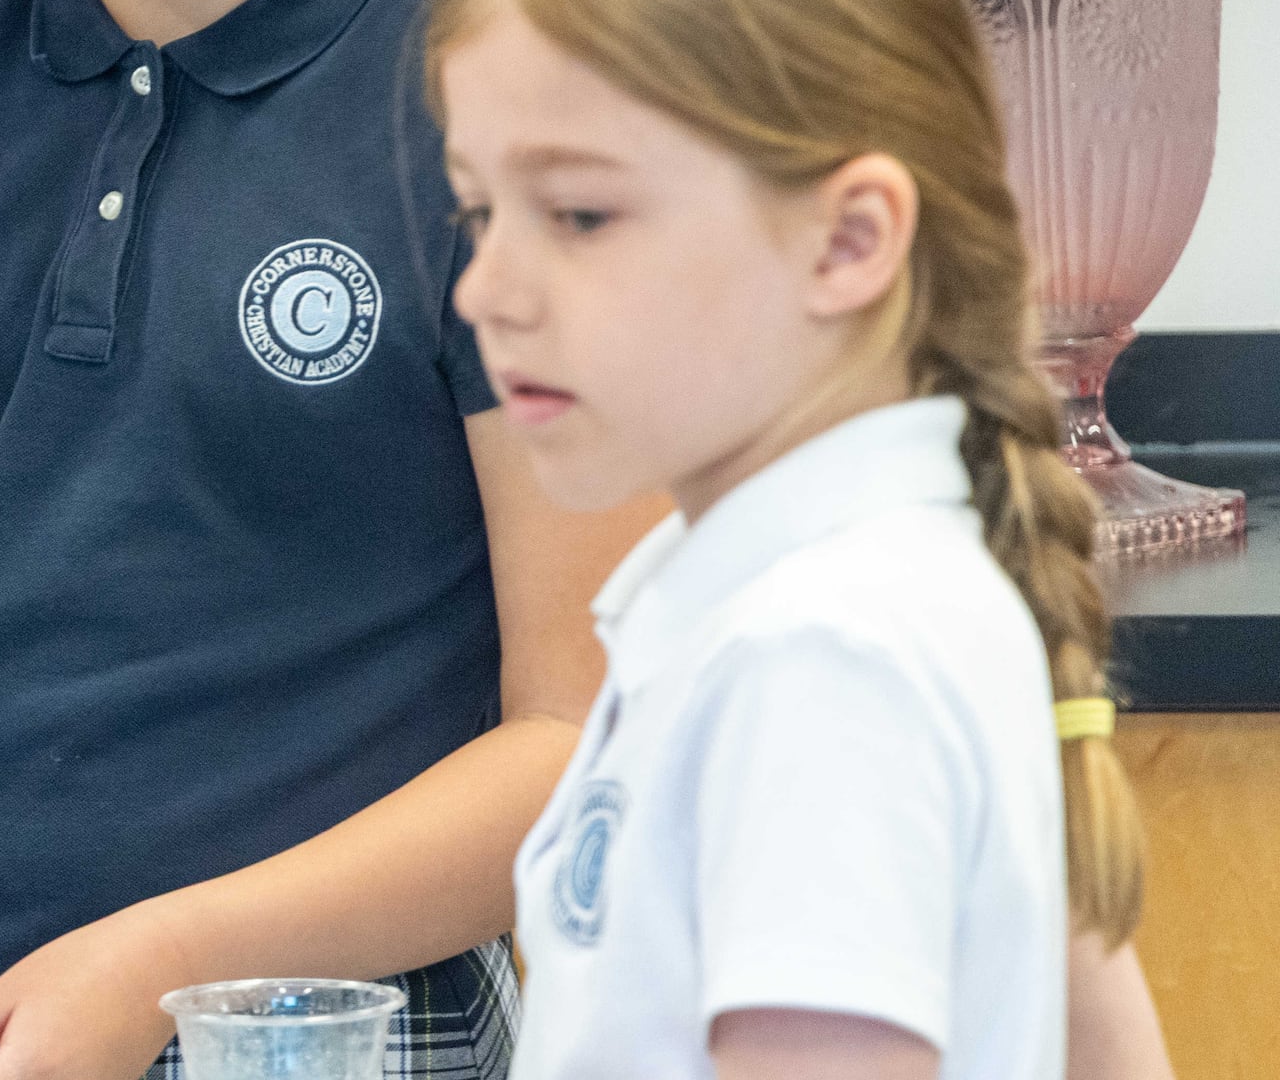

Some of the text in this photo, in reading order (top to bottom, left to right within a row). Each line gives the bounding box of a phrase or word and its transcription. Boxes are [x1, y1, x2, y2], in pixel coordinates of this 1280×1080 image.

[253, 247, 373, 317] CORNERSTONE
[291, 283, 332, 337] C
[247, 305, 369, 378] CHRISTIAN ACADEMY
